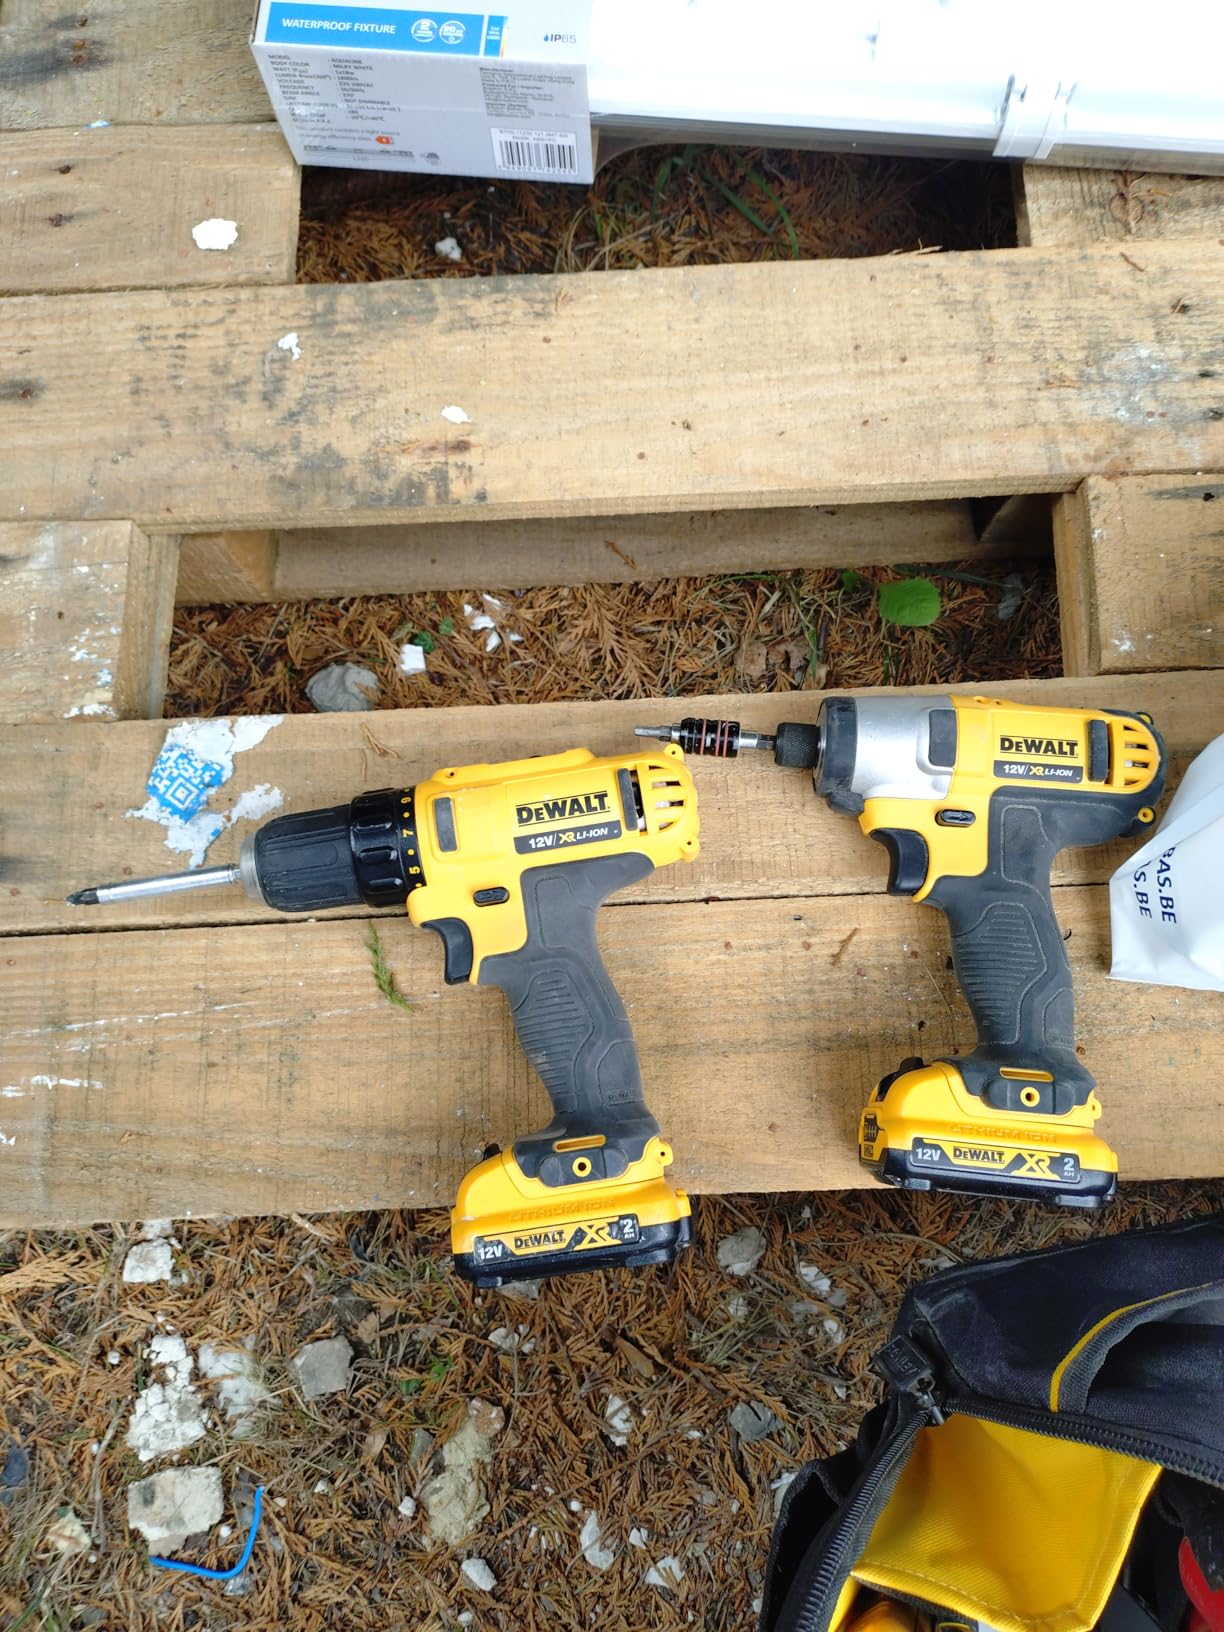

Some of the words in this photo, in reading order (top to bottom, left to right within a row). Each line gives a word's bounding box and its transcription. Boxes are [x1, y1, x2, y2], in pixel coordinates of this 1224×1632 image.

[282, 18, 352, 31] WATERPROOF
[353, 22, 397, 34] FIXTURE
[549, 33, 577, 44] IP65
[1029, 765, 1045, 776] XR
[1044, 767, 1074, 777] LI-ION
[402, 828, 414, 838] 7
[558, 831, 577, 845] XR
[576, 827, 609, 841] LI-ION
[408, 865, 421, 875] 5
[915, 1147, 942, 1161] 12V
[1017, 1153, 1052, 1178] XR
[1063, 1157, 1075, 1171] 2
[478, 1243, 503, 1260] 12V
[574, 1221, 615, 1250] XR
[623, 1219, 634, 1234] 2
